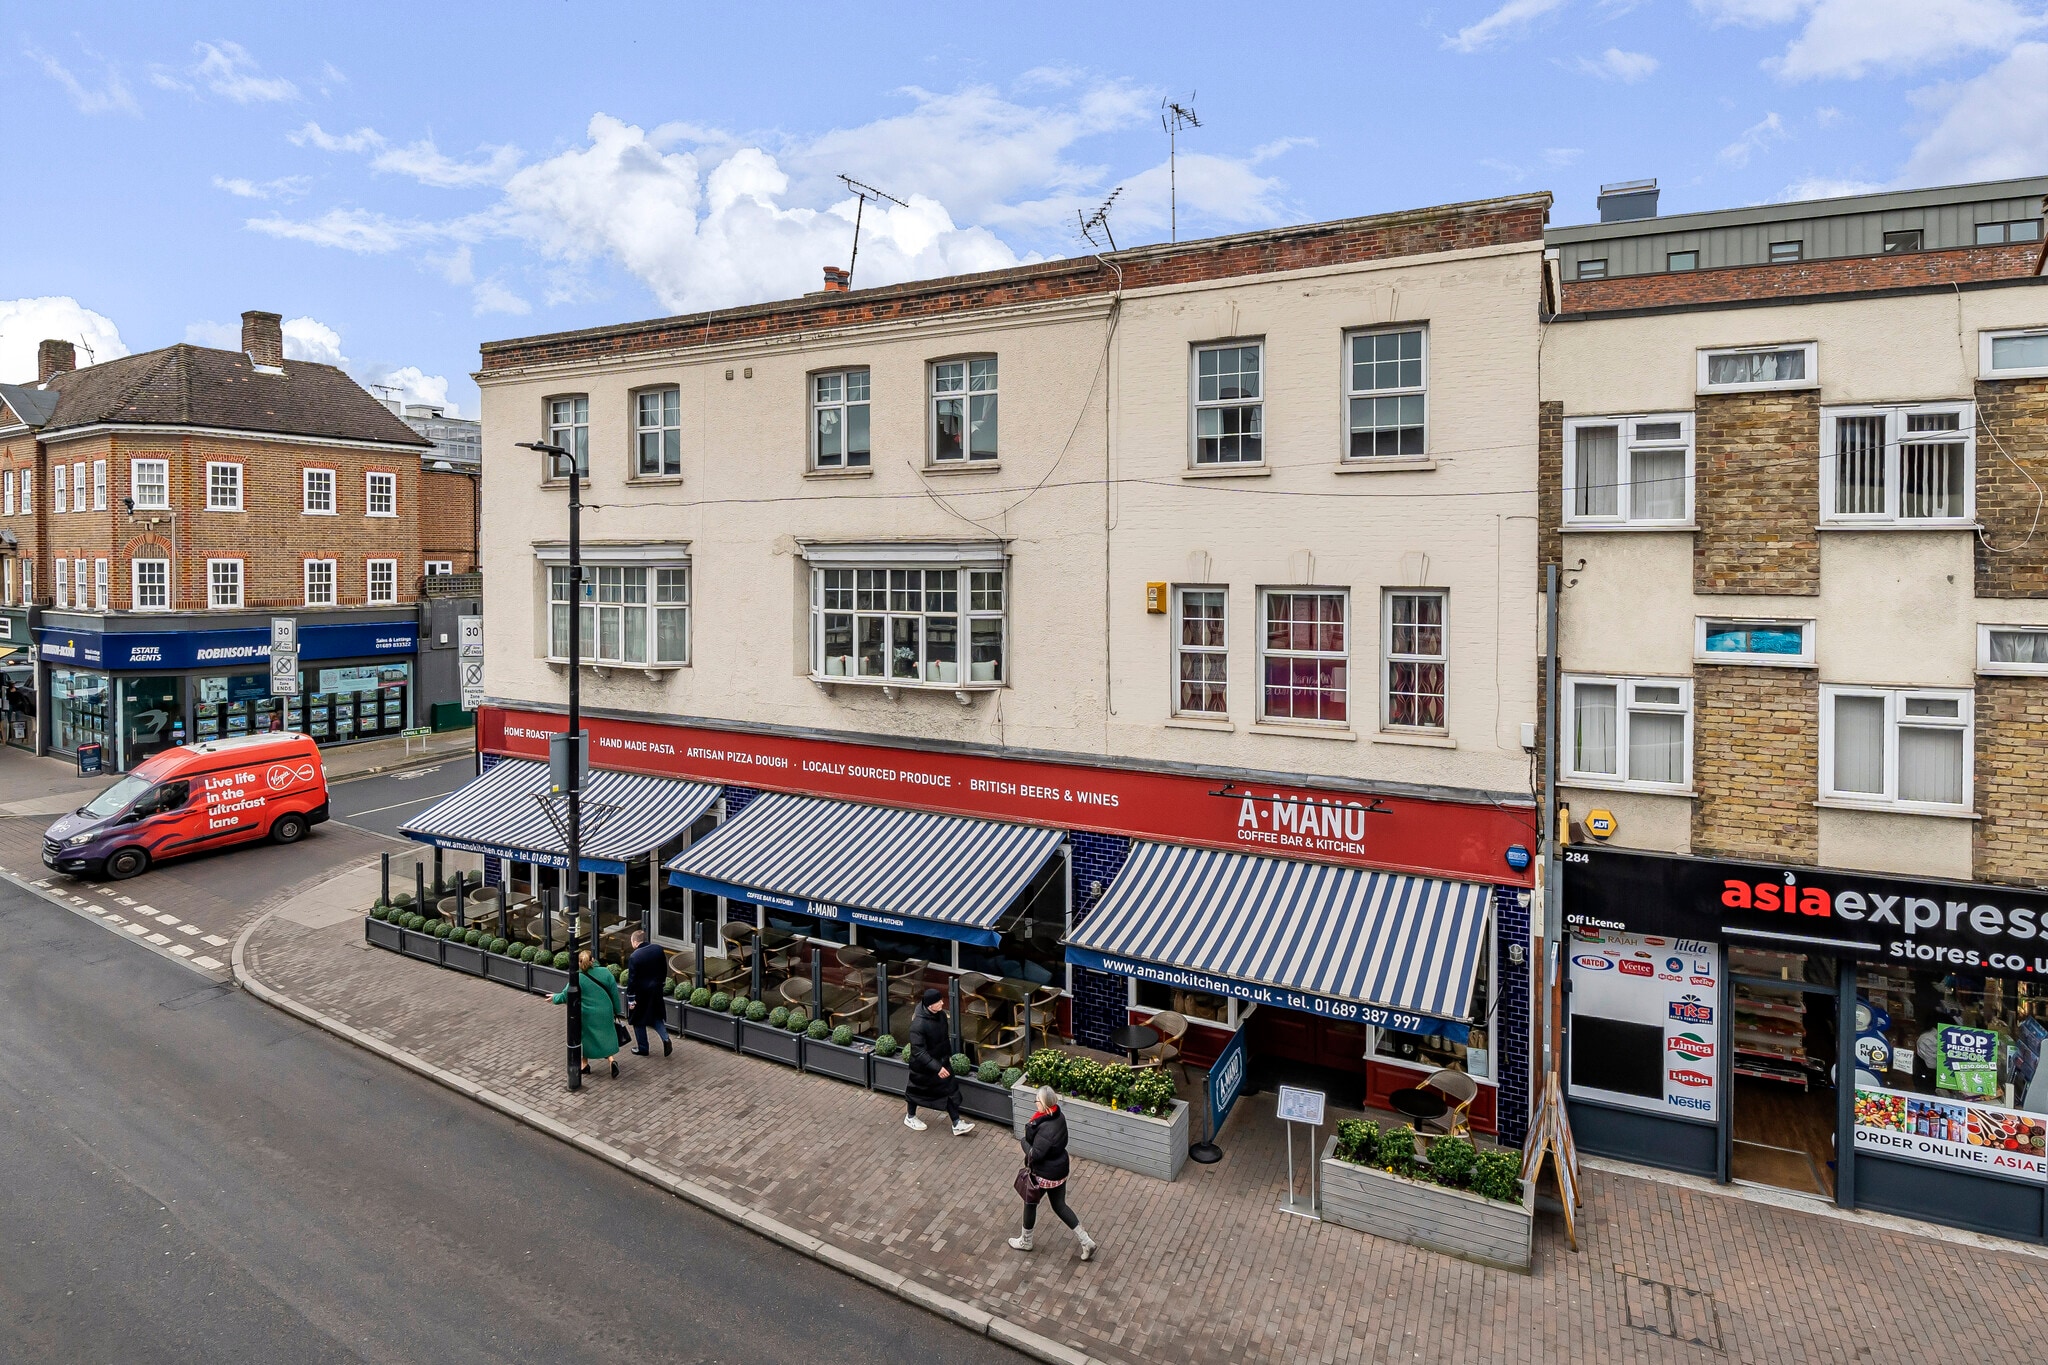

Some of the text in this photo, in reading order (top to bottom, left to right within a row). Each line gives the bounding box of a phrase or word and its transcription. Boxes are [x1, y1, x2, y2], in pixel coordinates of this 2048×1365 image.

[277, 627, 289, 636] 30
[466, 627, 479, 637] 30
[129, 654, 162, 662] AGENTS
[131, 646, 160, 655] ESTATE
[504, 726, 524, 738] HOME
[600, 737, 675, 755] HAND MADE PASTA
[686, 747, 788, 769] ARTISAN PIZZA DOUGH
[204, 772, 256, 790] Live life
[802, 760, 951, 787] LOCALLY SOURCED PRODUCE
[206, 788, 244, 803] in the
[970, 779, 1119, 807] BRITISH BEERS & WINES
[208, 796, 266, 816] ultrafast
[209, 816, 239, 829] lane
[1594, 820, 1608, 829] ADT
[1237, 829, 1365, 855] COFFEE BAR & KITCHEN
[531, 852, 551, 864] 01689
[552, 856, 565, 866] 387
[1565, 852, 1589, 863] 284
[747, 891, 762, 901] COFFEE
[762, 894, 771, 903] BAR
[776, 896, 794, 907] KITCHEN
[852, 912, 868, 921] COFFEE
[868, 914, 878, 923] BAR
[883, 917, 904, 927] KITCHEN
[1567, 914, 1626, 930] Off Licence
[1608, 935, 1638, 946] RAJAH
[1674, 938, 1708, 954] Tilda
[1581, 957, 1605, 968] NATCO
[1622, 960, 1651, 973] Veetee
[1103, 957, 1271, 1002] www.amanokitchen.co.uk
[1288, 993, 1310, 1010] tel.
[1314, 998, 1357, 1018] 01689
[1362, 1006, 1389, 1024] 387
[1393, 1014, 1421, 1031] 997
[1671, 1003, 1710, 1019] TRS
[1669, 1038, 1711, 1054] Limca
[1947, 1031, 1988, 1048] TOP
[1947, 1043, 1975, 1053] PRIZES
[1672, 1072, 1709, 1084] Lipton
[1856, 1130, 1913, 1149] ORDER
[1919, 1142, 1988, 1164] ONLINE:
